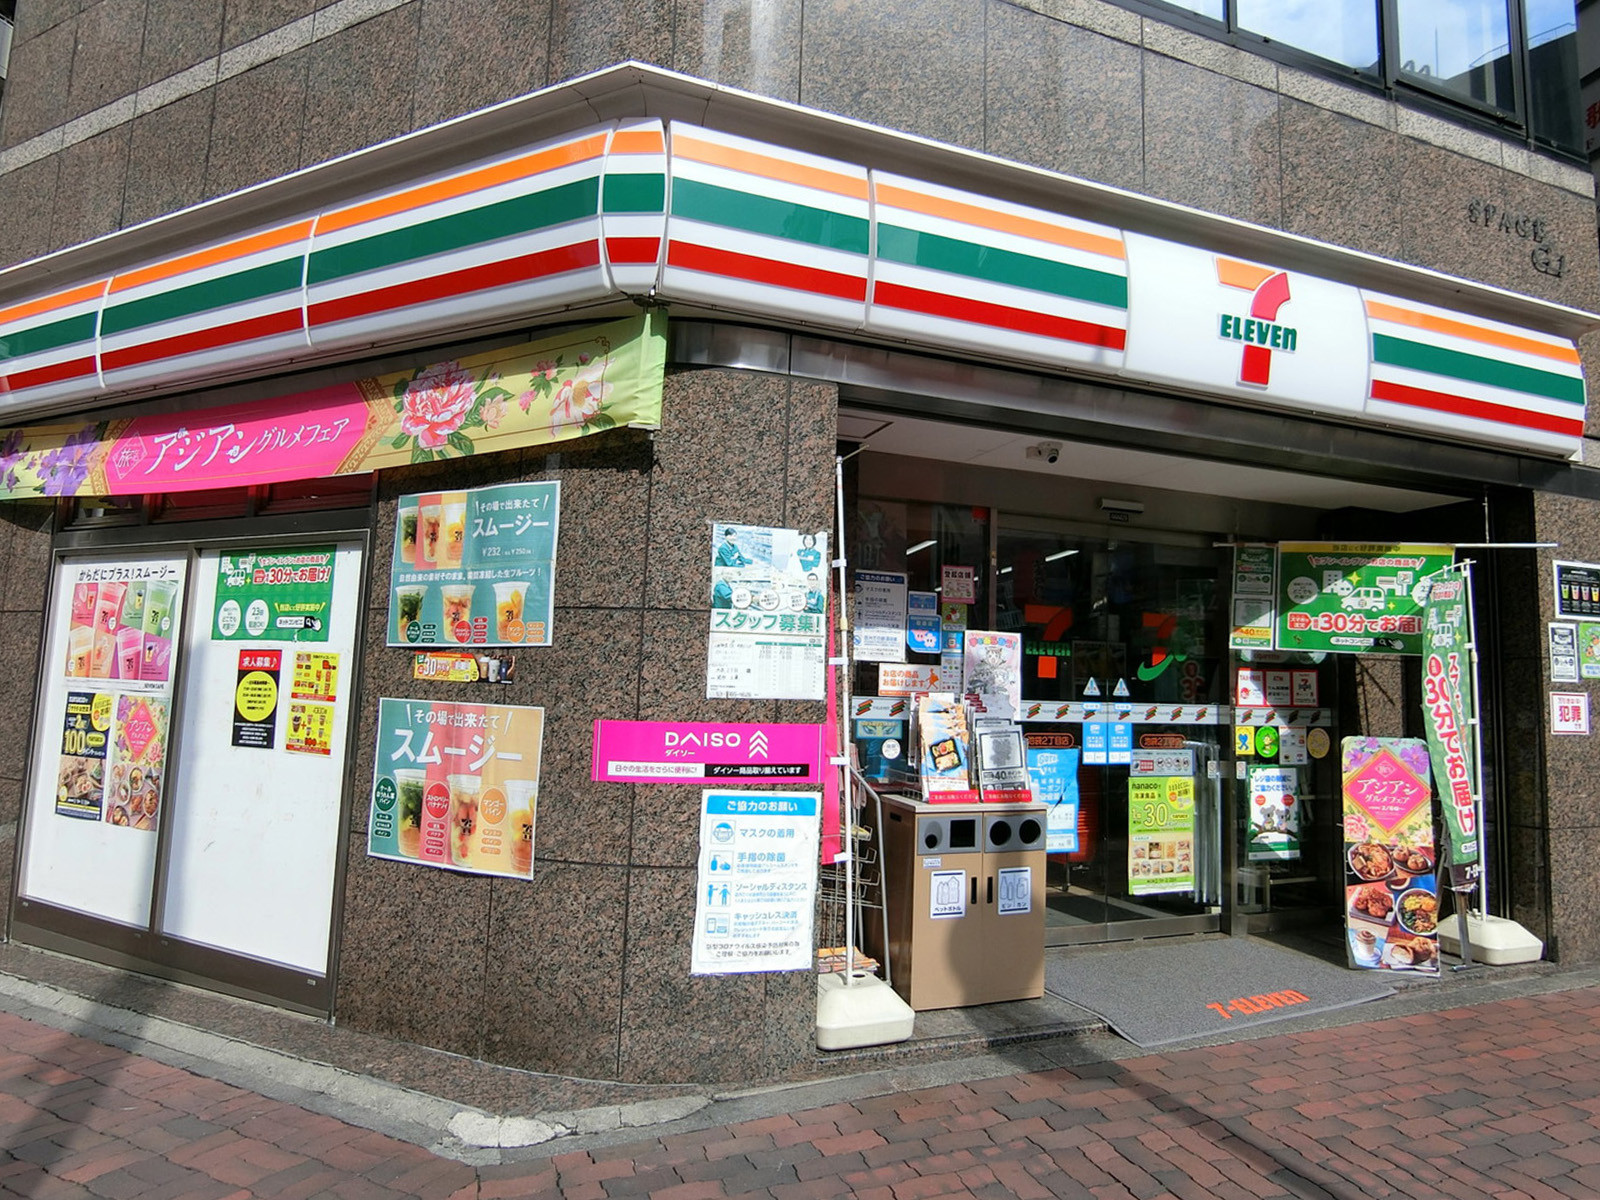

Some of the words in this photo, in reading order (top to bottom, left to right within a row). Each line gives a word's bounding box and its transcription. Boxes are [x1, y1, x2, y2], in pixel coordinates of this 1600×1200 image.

[1468, 200, 1546, 243] SPACE
[1215, 258, 1291, 386] 7
[144, 423, 257, 475] アジアン
[256, 418, 349, 455] グルメフェア
[480, 498, 540, 513] その場で出来たて
[472, 513, 549, 539] スムージー
[715, 611, 821, 633] スタッフ募集!
[883, 669, 919, 679] お店の商品
[883, 679, 925, 688] お届けします
[413, 709, 501, 729] その場で出来たて
[1558, 705, 1582, 722] 犯罪
[65, 728, 86, 755] 100
[665, 731, 741, 748] DAISO
[391, 728, 523, 772] スムージー
[665, 748, 695, 757] ダイソー
[995, 770, 1006, 780] 40
[1357, 778, 1419, 795] アジアン
[726, 800, 798, 812] ご協力のお願い
[1143, 802, 1168, 827] 30
[739, 828, 795, 839] マスクの着用
[737, 852, 786, 862] 手指の除菌
[735, 882, 808, 891] ソーシャルディスタンス
[734, 911, 798, 920] キャッシュレス決済
